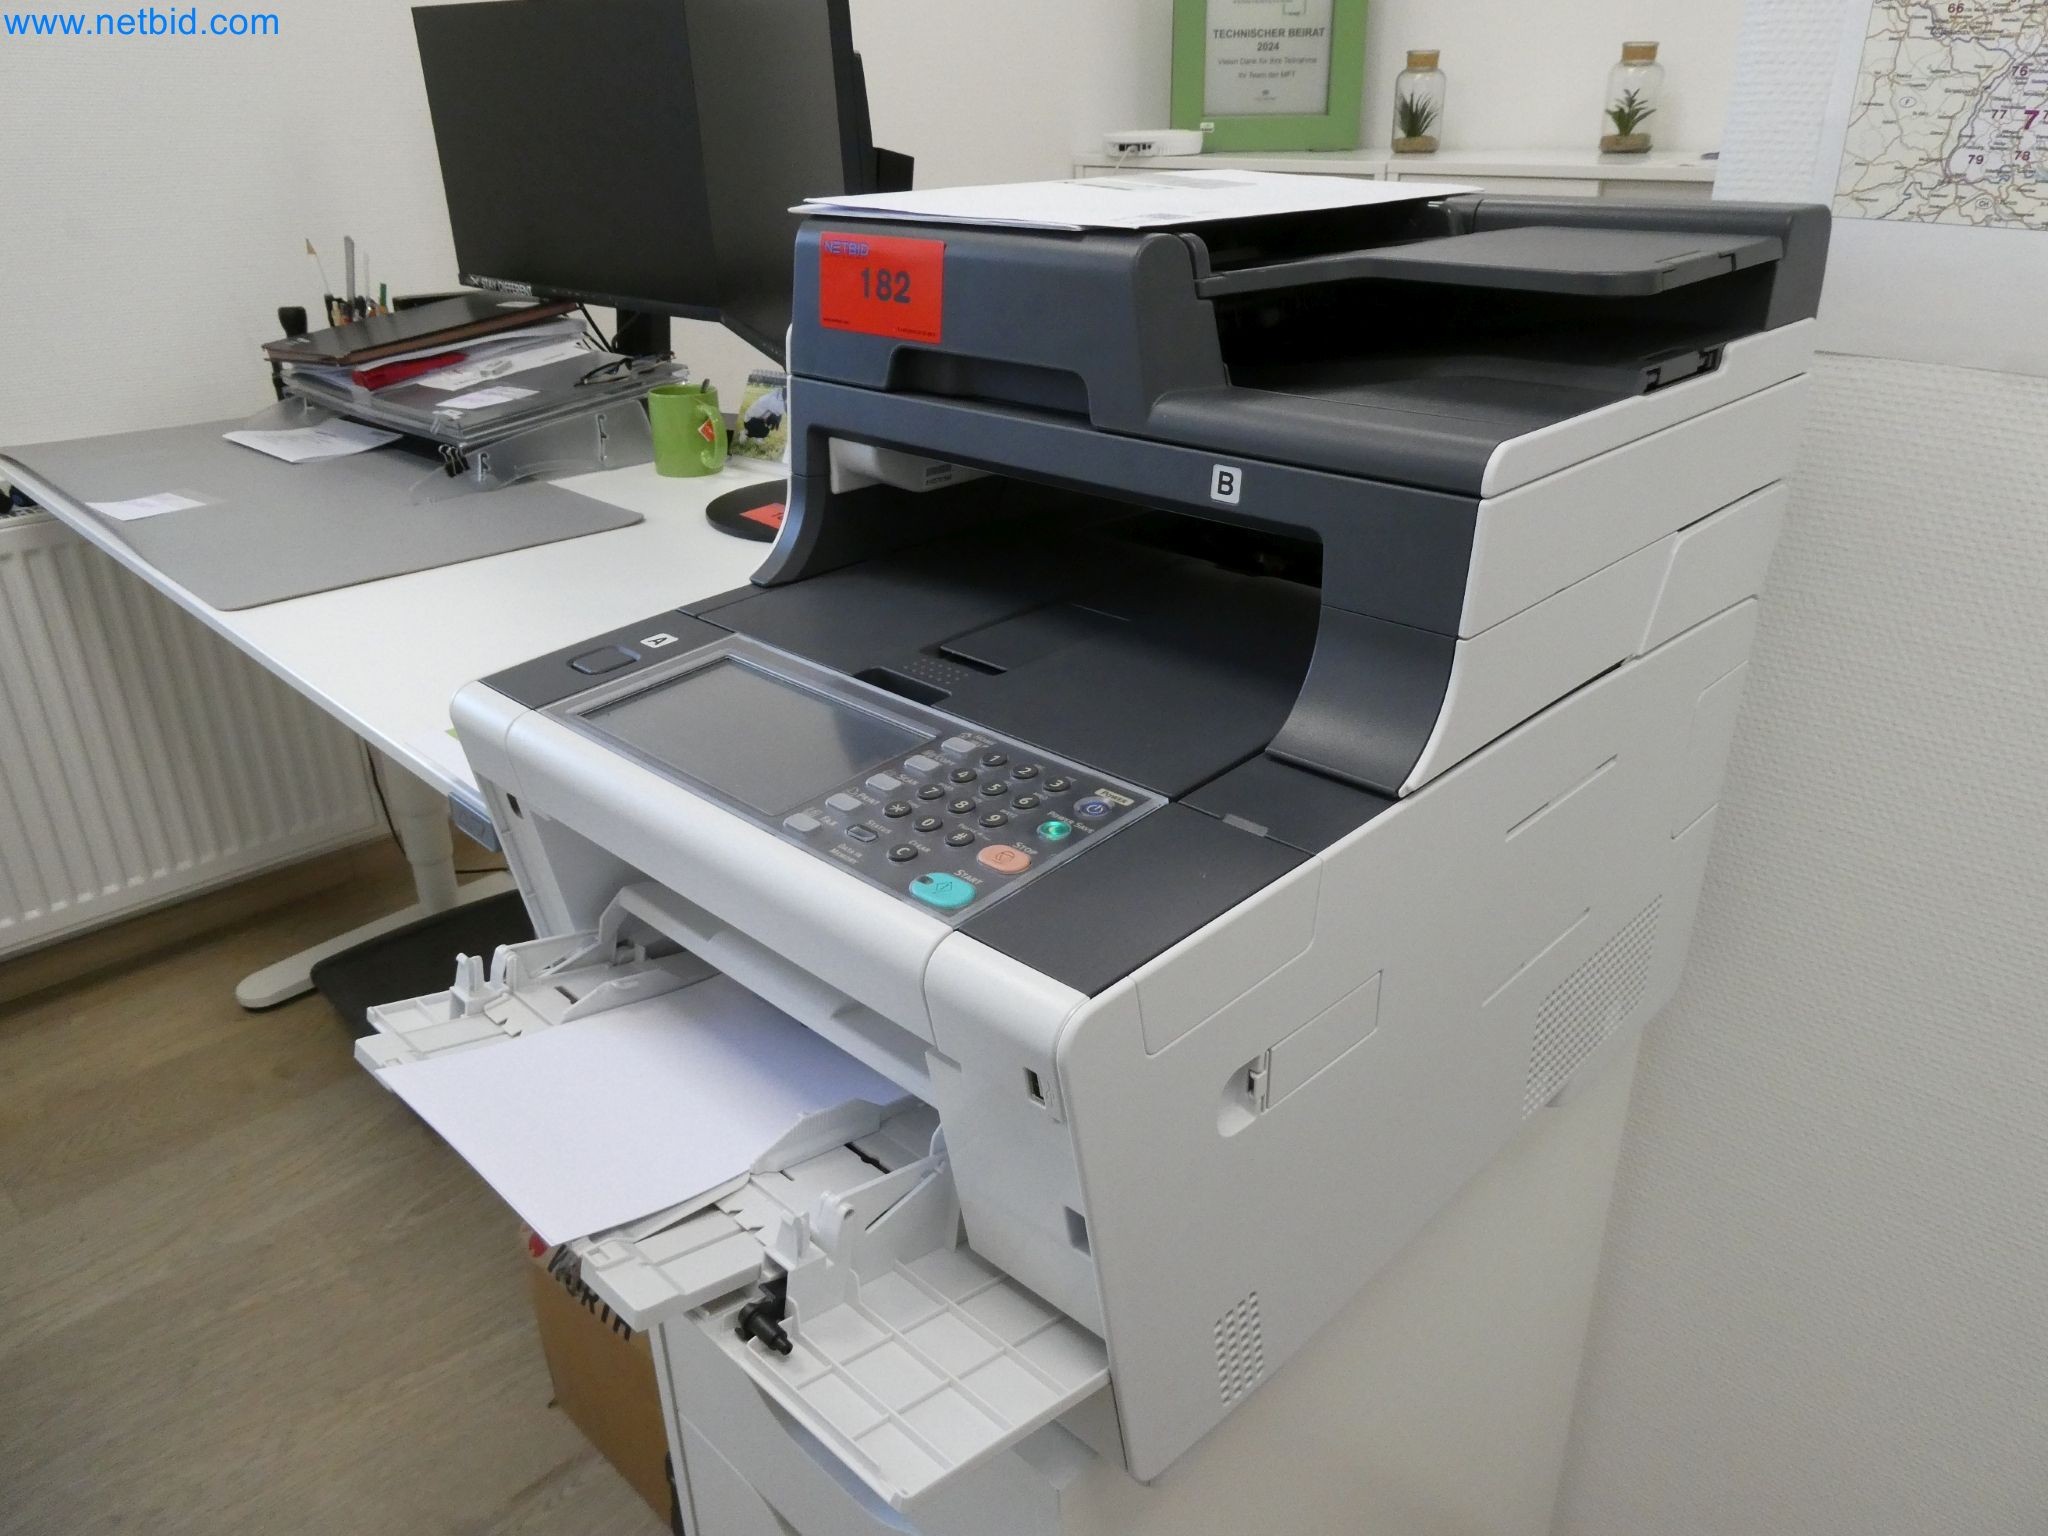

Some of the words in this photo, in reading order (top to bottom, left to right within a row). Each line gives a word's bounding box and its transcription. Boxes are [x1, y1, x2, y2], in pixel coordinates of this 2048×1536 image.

[1947, 3, 1965, 13] 66
[1213, 28, 1286, 39] TECHNISCHER
[1288, 26, 1326, 38] BEIRAT
[1257, 42, 1280, 52] 2024
[2012, 65, 2029, 76] 76
[1991, 109, 2008, 119] 77
[2024, 109, 2040, 130] 7
[1968, 154, 1985, 165] 79
[2015, 150, 2031, 161] 78
[824, 240, 871, 257] NETBID
[861, 267, 912, 304] 182
[1217, 470, 1235, 496] B
[647, 636, 668, 647] A
[989, 754, 1002, 762] 1
[957, 770, 970, 778] 4
[1017, 766, 1033, 775] 2
[986, 782, 1002, 792] 5
[1049, 779, 1065, 788] 3
[924, 786, 941, 795] 7
[954, 800, 970, 809] 8
[1018, 796, 1034, 805] 6
[921, 818, 936, 827] 0
[985, 814, 1002, 823] 9
[895, 846, 912, 856] C
